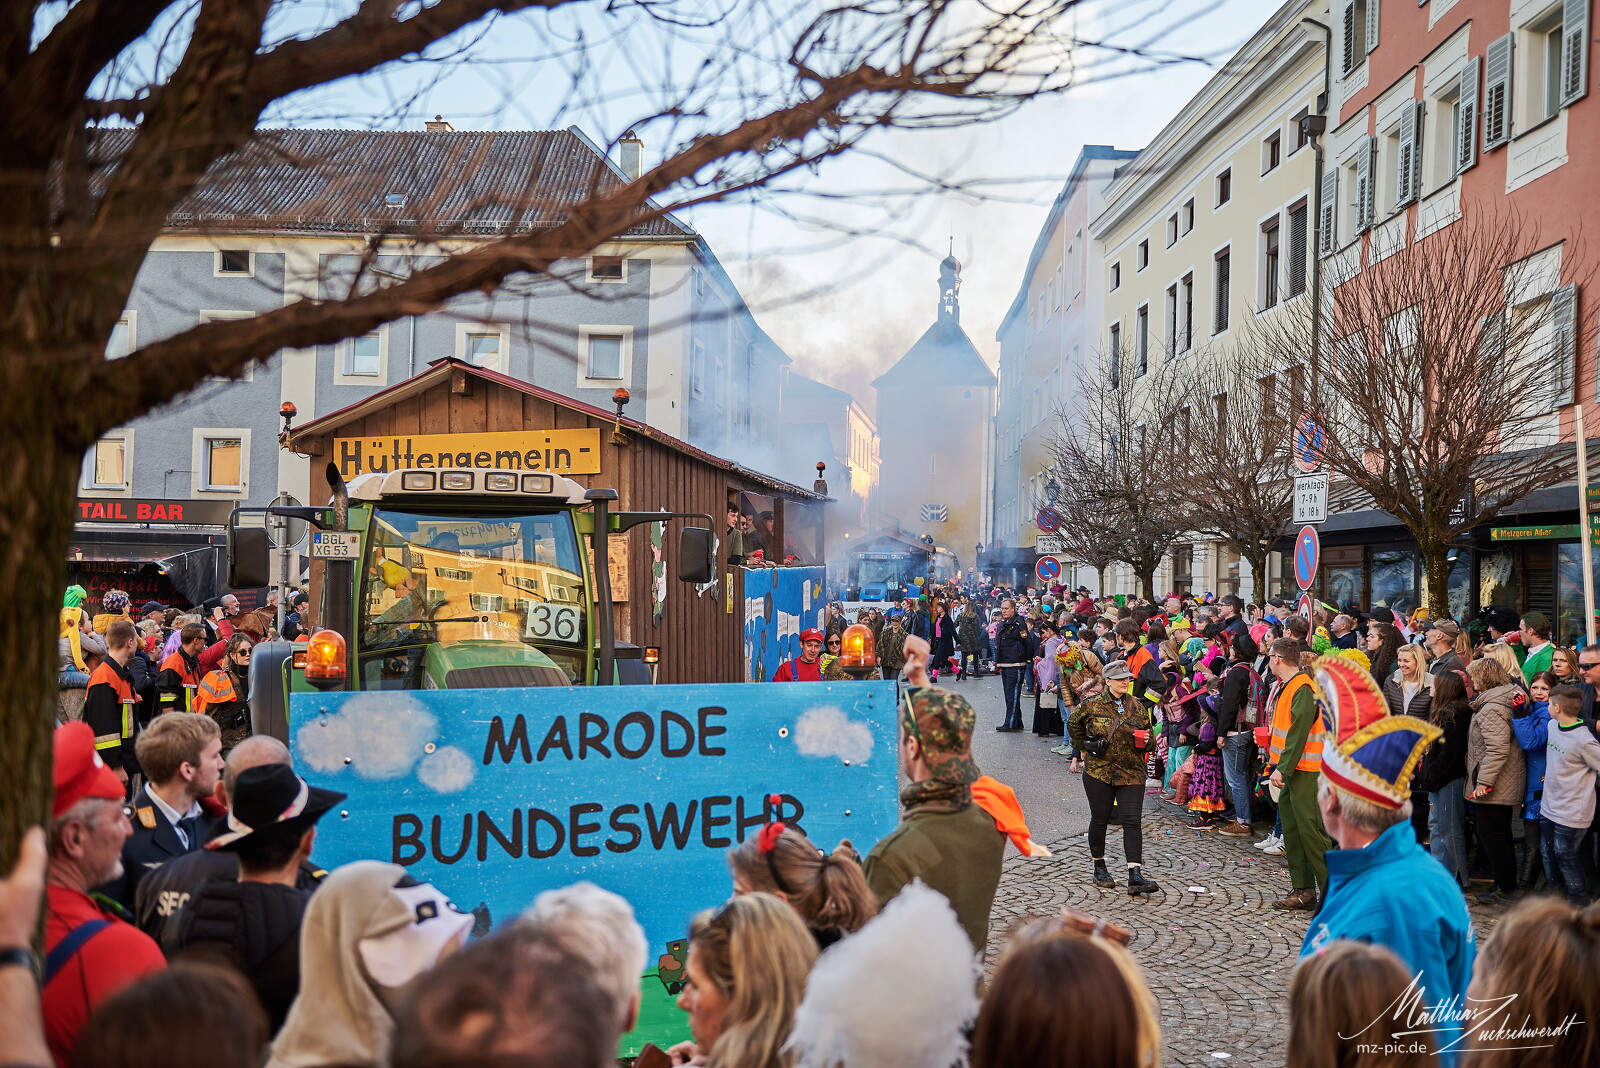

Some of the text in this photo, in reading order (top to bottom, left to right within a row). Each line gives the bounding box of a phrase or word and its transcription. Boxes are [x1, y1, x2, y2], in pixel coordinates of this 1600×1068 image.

[1296, 480, 1325, 491] werktags
[136, 503, 184, 521] BAR
[322, 534, 346, 545] BGL
[1500, 529, 1533, 538] Metzgerei
[315, 545, 349, 556] XG 53
[88, 576, 160, 592] Cocktail
[530, 605, 576, 640] 36
[483, 706, 727, 765] MARODE
[392, 794, 807, 866] BUNDESWEHR
